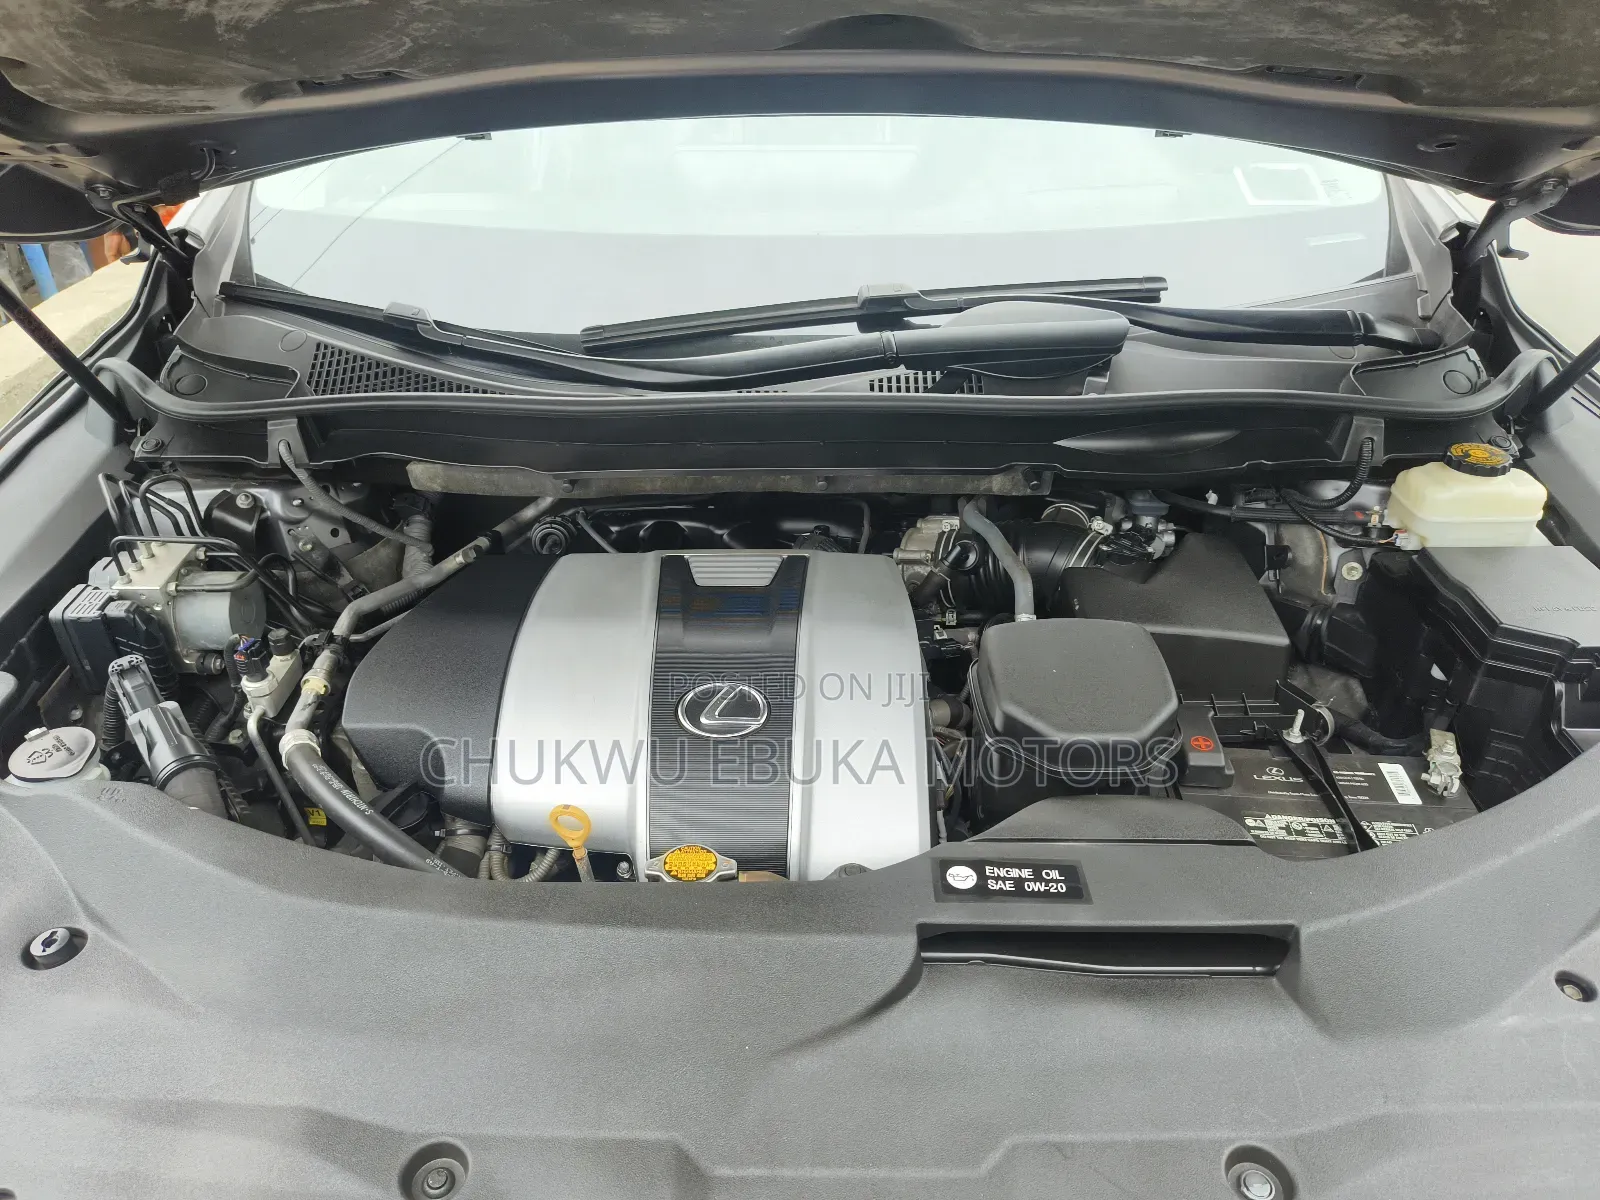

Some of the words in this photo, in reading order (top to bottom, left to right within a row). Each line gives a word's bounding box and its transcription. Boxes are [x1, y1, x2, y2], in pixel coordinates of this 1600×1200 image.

[1253, 774, 1304, 783] LEXUS
[985, 865, 1034, 879] ENGINE
[1041, 869, 1065, 880] OIL
[987, 879, 1015, 891] SAE
[1024, 881, 1066, 893] 0W-20
